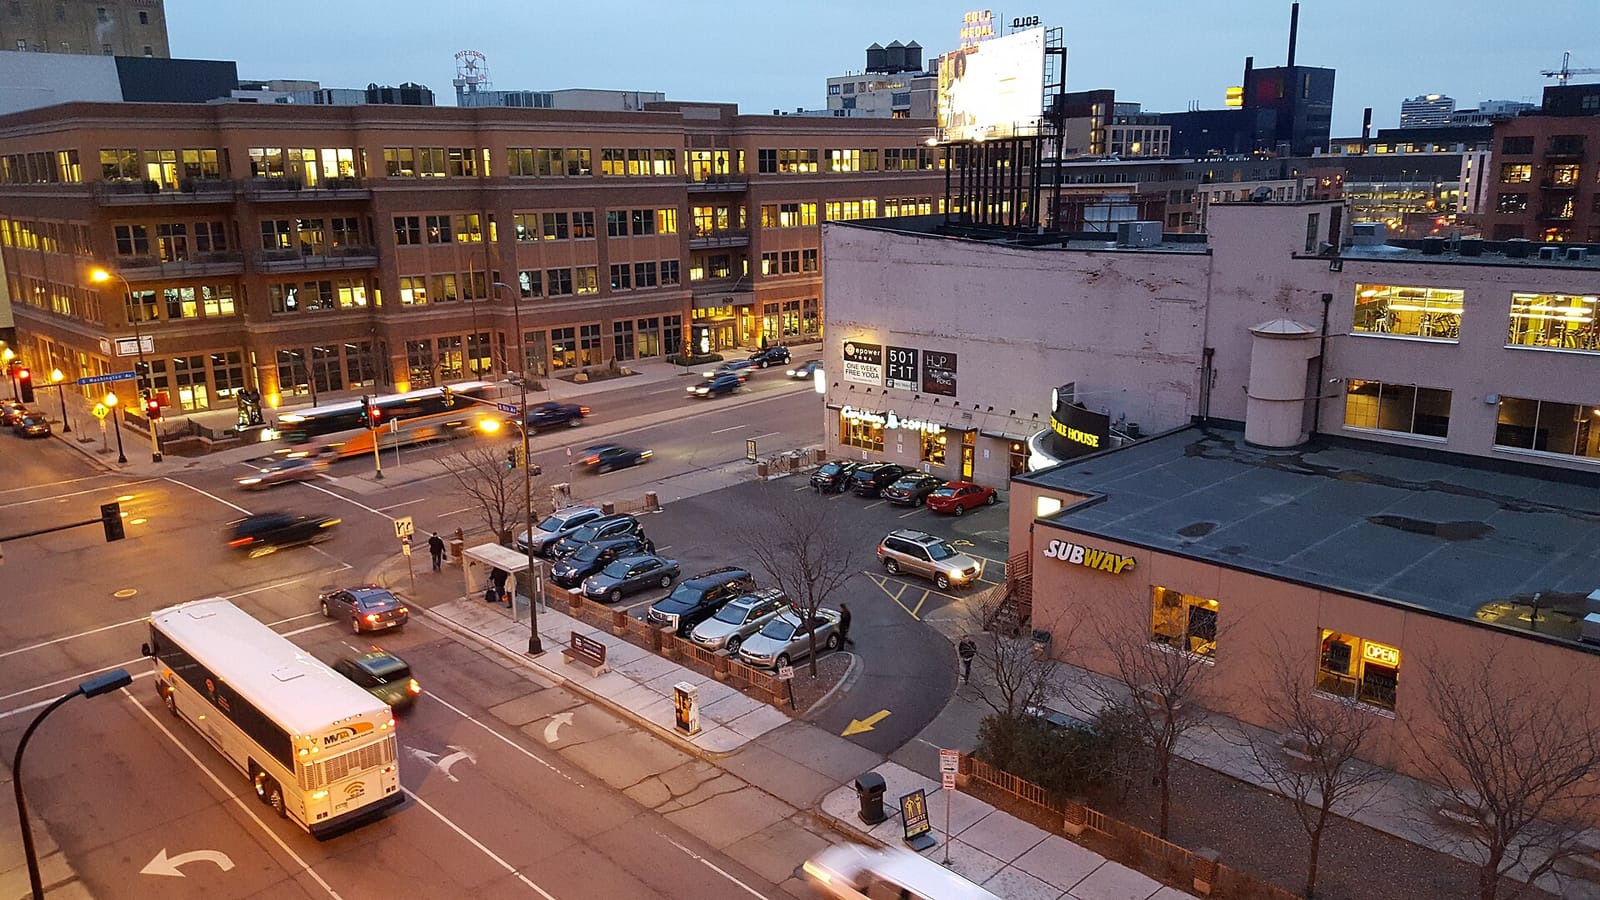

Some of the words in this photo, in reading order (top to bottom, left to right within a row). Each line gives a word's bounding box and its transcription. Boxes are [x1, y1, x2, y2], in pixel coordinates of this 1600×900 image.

[889, 349, 914, 364] 501
[845, 368, 861, 377] FREE
[862, 371, 880, 380] YOGA
[846, 362, 859, 371] ONE
[860, 364, 878, 374] WEEK
[1067, 427, 1099, 448] HOUSE
[1043, 540, 1136, 575] SUBWAY
[1367, 645, 1396, 662] OPEN
